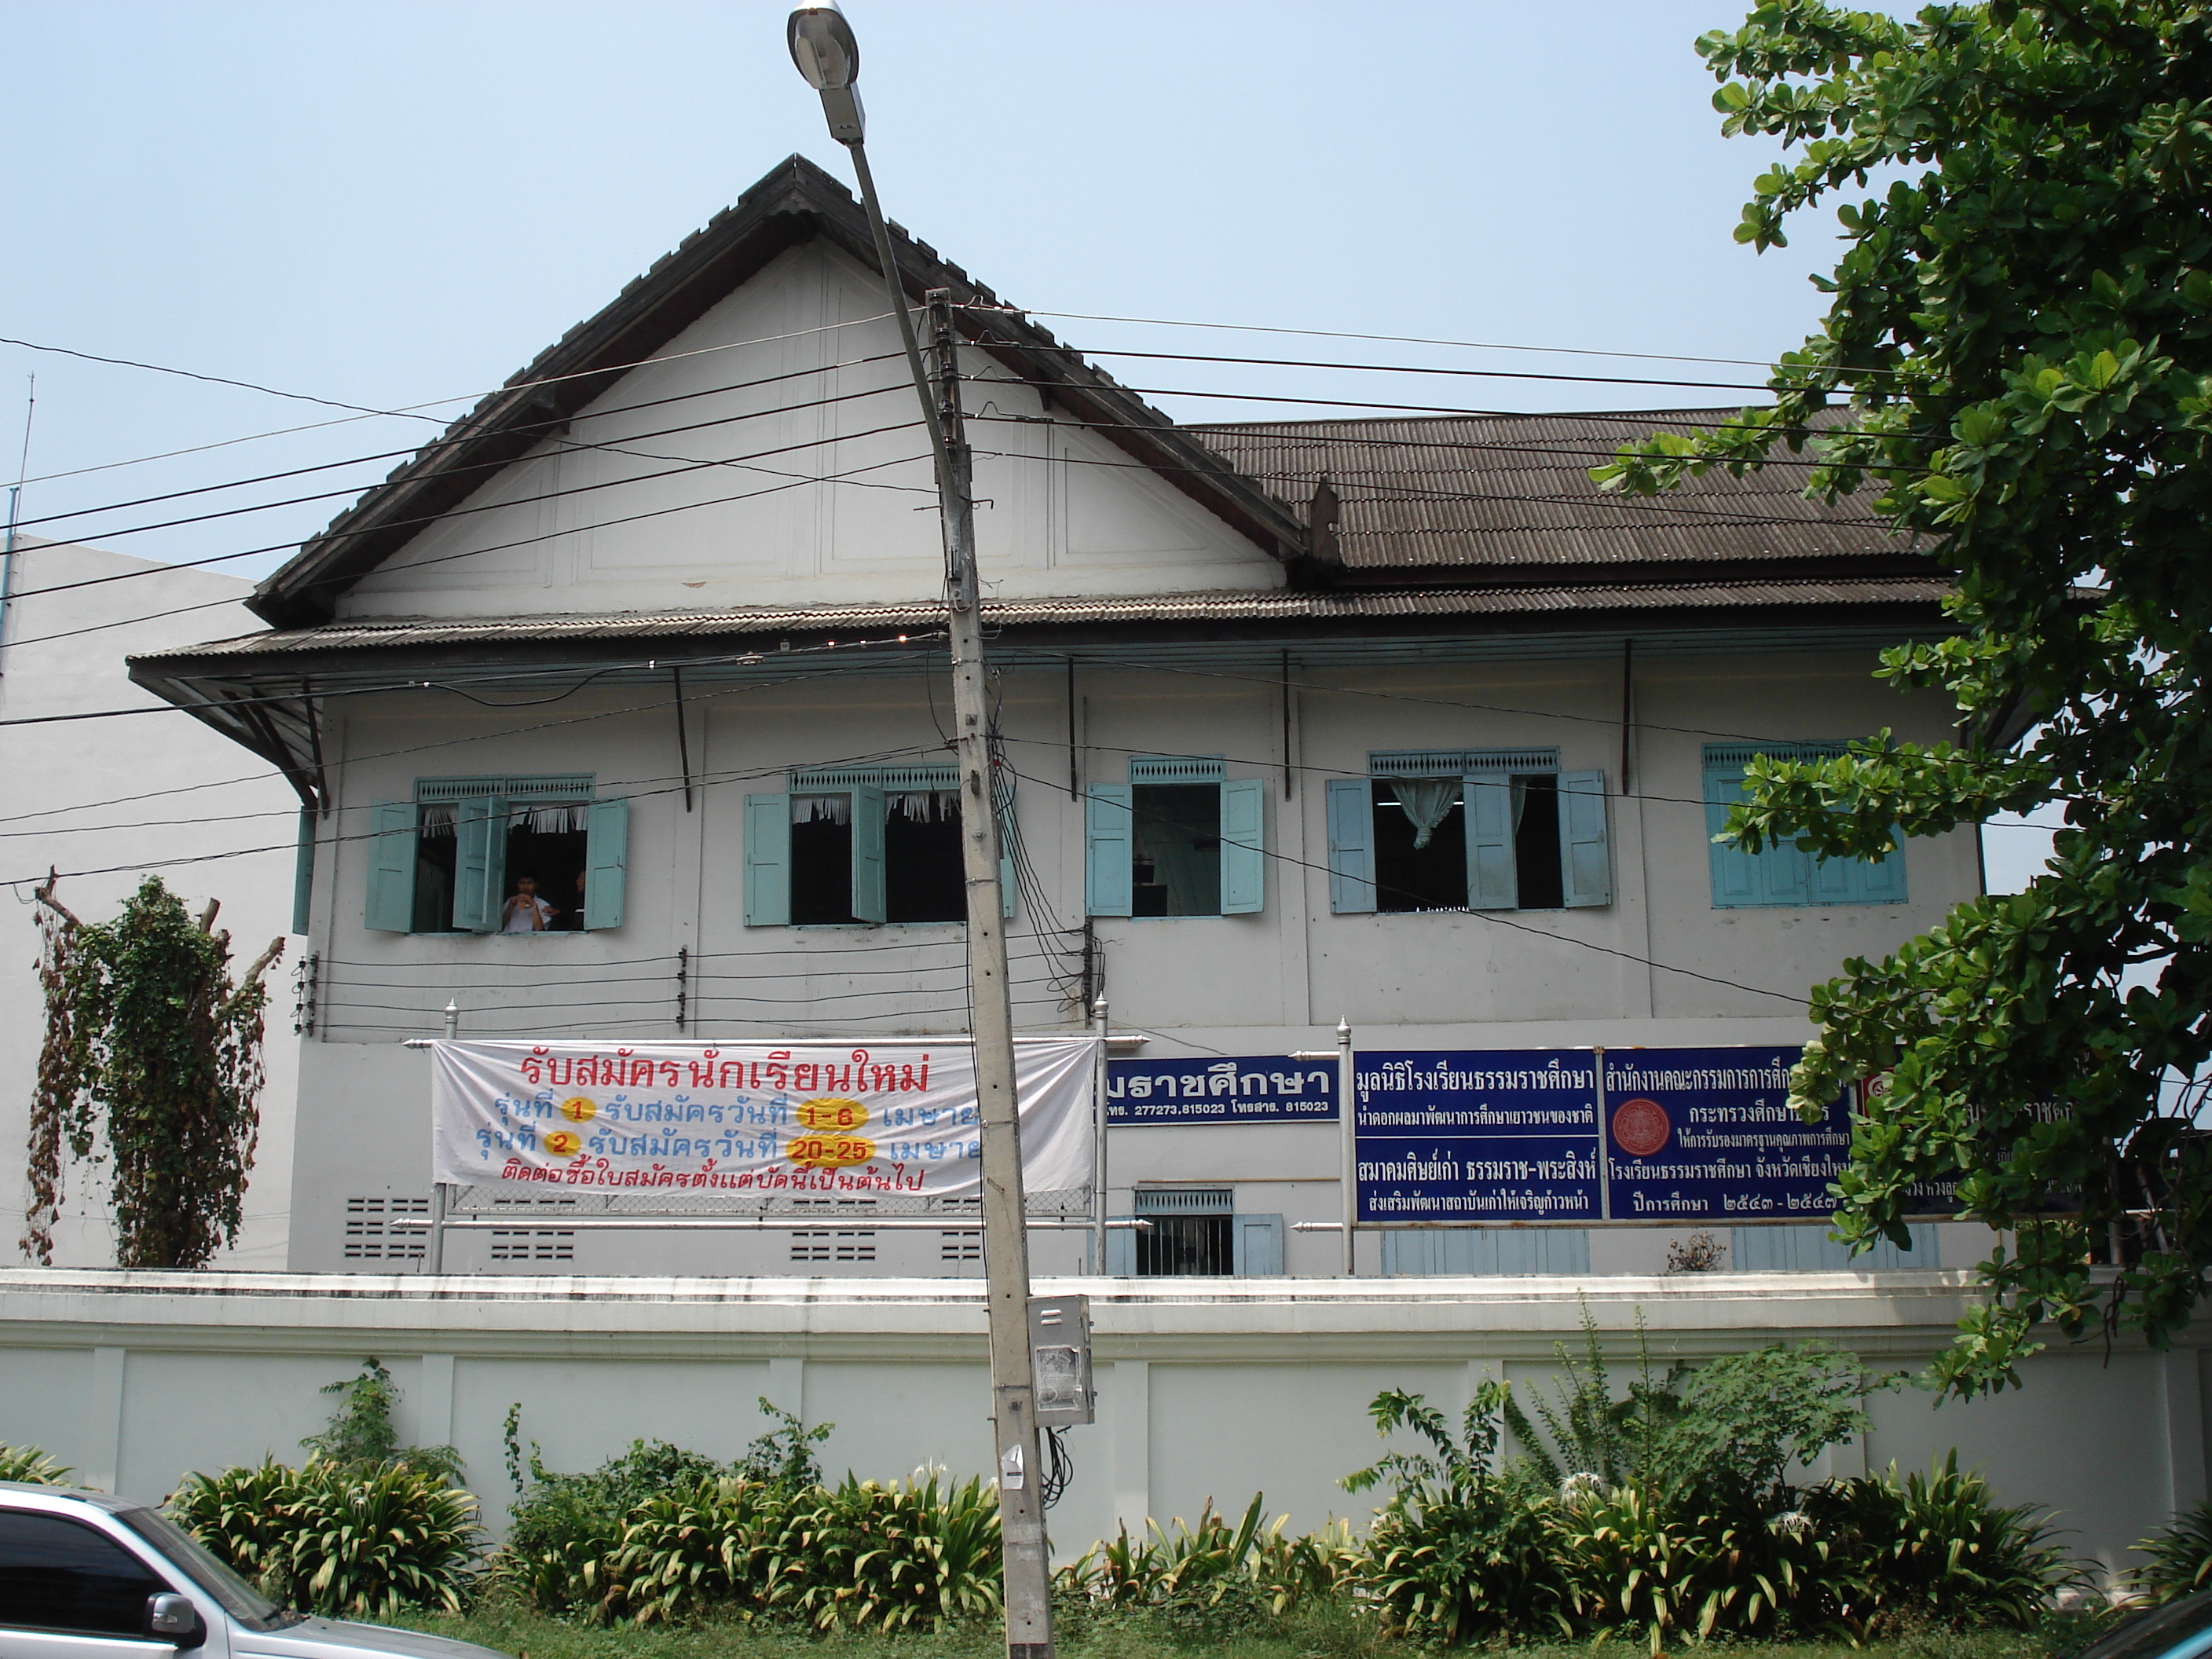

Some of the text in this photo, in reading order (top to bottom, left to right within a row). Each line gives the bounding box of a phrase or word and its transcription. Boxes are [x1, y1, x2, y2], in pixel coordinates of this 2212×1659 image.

[520, 1046, 929, 1092] รับสมัครนักเรียนใหม่
[1106, 1061, 1329, 1098] มราชศึกษา
[1356, 1058, 1595, 1103] มูลนิธิโรงเรียนธรรมราชศึกษา
[494, 1088, 979, 1126] รุ่นที่ 1 รับสมัครวันที่ 1-6 เมษาย
[1285, 1101, 1329, 1112] 815023
[476, 1121, 980, 1160] รุ่นที่ 2 รับสมัครวันที่ 20-25 เมษาย
[1357, 1147, 1597, 1182] สมาคมศิษย์เก่า ธรรมราช-พระสิงห์
[1607, 1157, 1751, 1181] โรงเรียนธรรมราชศึกษา
[1633, 1191, 1709, 1213] ปีการศึกษา
